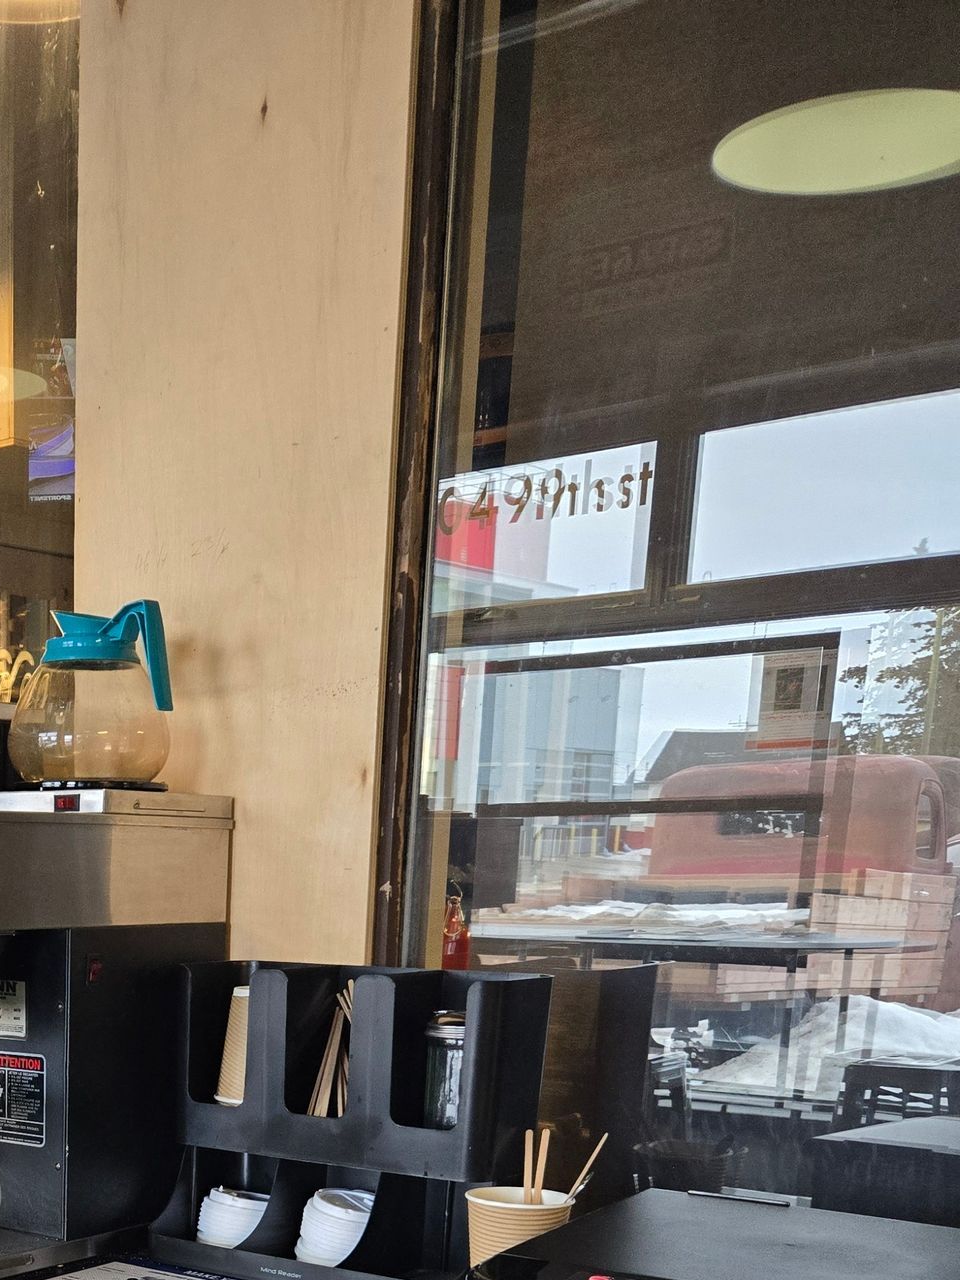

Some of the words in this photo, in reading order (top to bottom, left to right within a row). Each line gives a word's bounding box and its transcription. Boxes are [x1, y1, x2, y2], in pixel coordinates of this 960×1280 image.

[183, 1270, 220, 1280] MAKE
[260, 1266, 277, 1275] Mind
[277, 1269, 302, 1279] Reader
